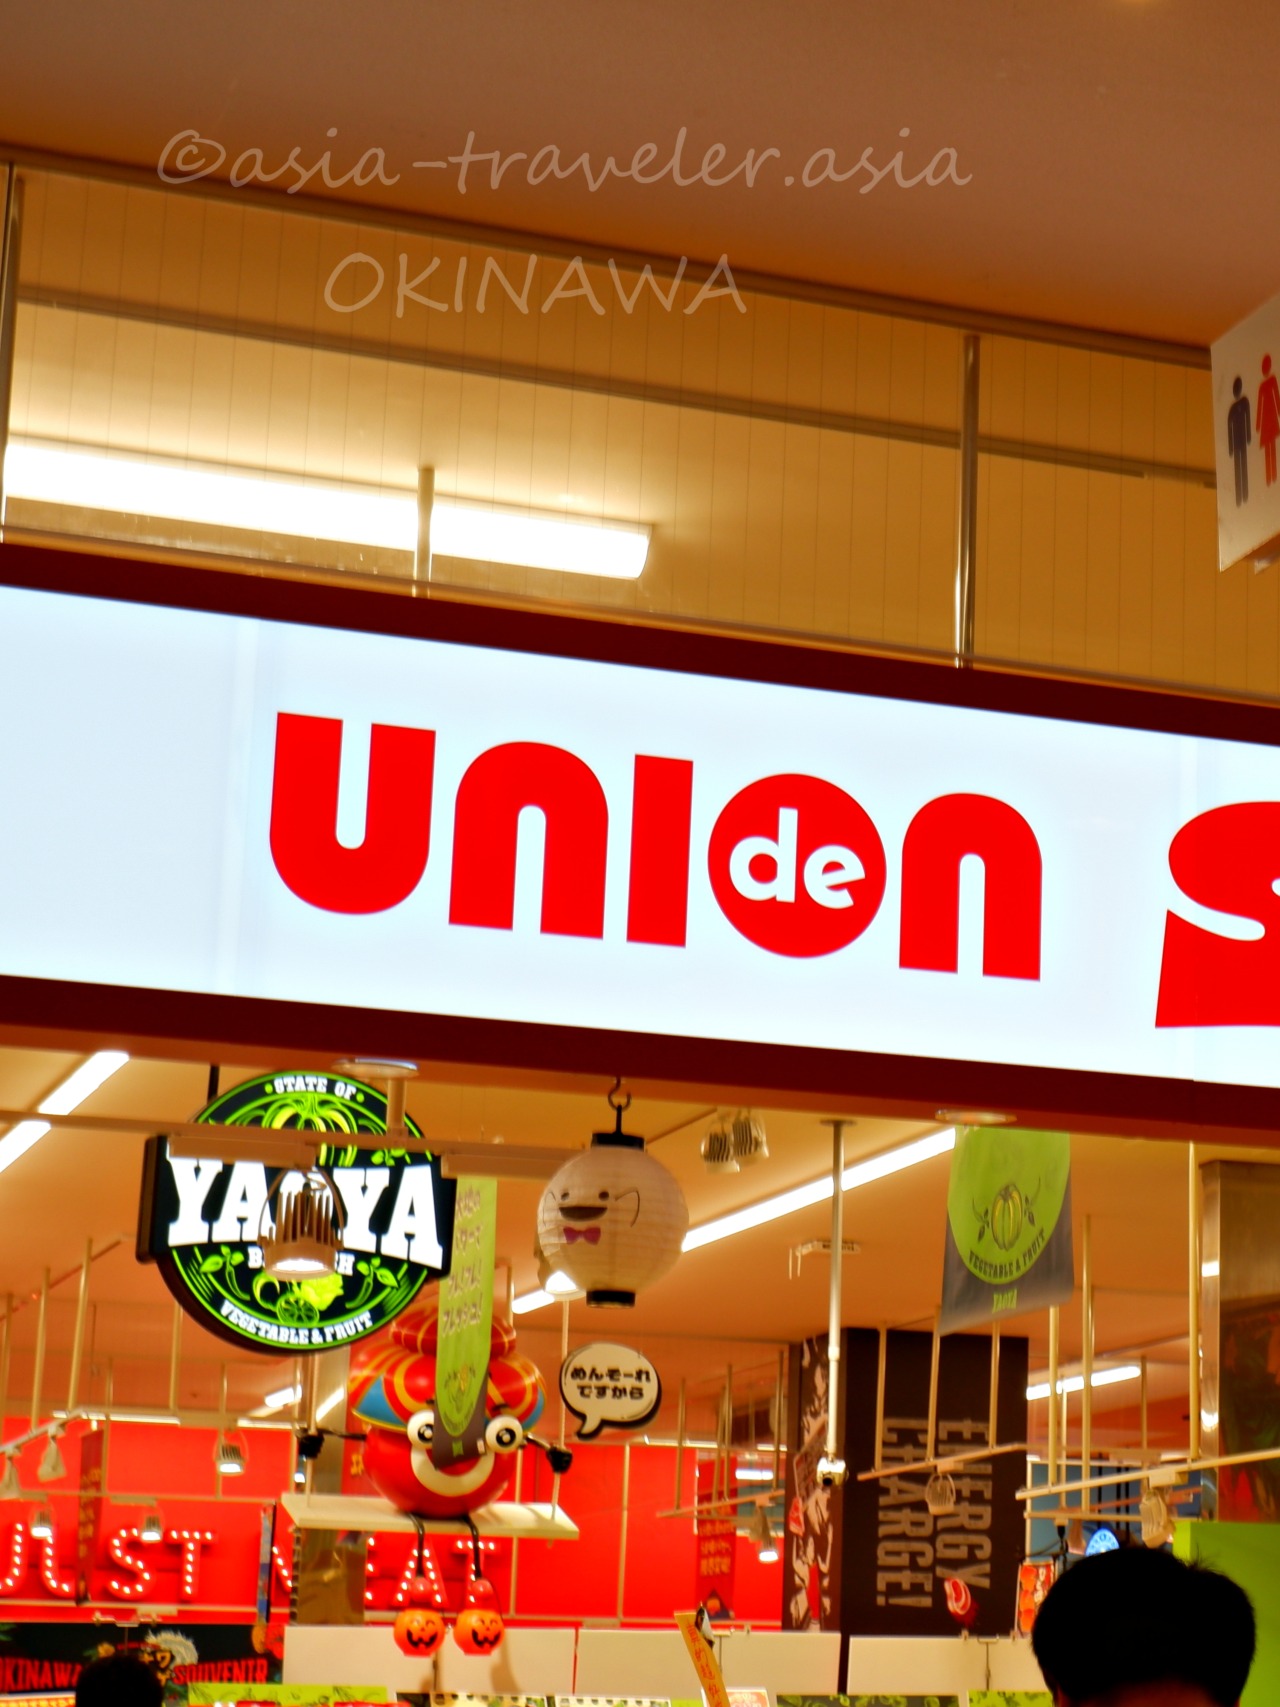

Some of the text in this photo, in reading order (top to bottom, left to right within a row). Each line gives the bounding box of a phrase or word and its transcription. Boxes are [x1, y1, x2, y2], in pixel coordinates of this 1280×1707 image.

[268, 710, 1043, 983] UNION
[729, 805, 866, 910] de
[274, 1075, 358, 1101] STATE OF
[968, 1250, 1014, 1280] VEGETABLE
[1022, 1227, 1046, 1268] FRUIT
[219, 1299, 374, 1345] VEGETABLE & FRUIT
[576, 1384, 645, 1400] ですから
[876, 1417, 935, 1608] CHARGE!
[936, 1420, 993, 1590] ENERGY
[0, 1656, 83, 1692] KINAW
